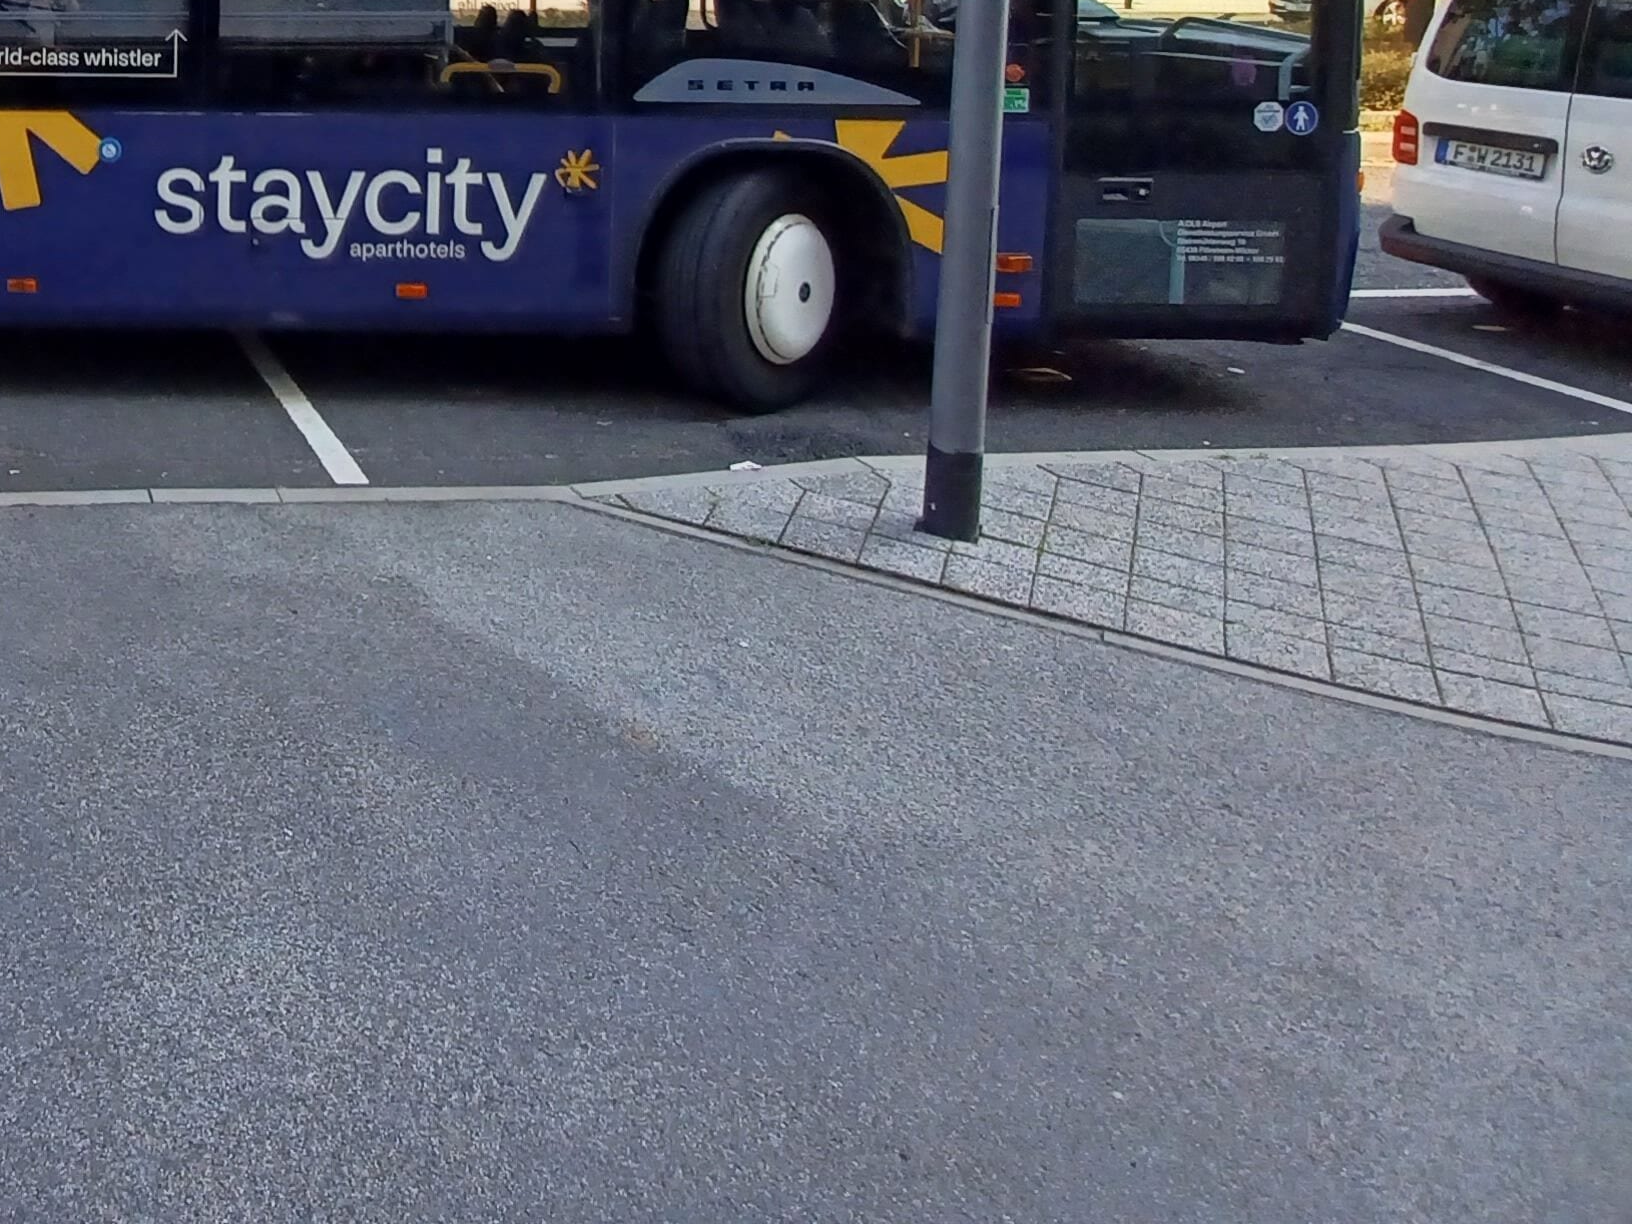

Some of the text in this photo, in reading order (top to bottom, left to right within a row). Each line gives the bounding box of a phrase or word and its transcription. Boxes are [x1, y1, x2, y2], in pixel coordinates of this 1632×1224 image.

[84, 48, 162, 67] whistler
[687, 79, 815, 91] SETRA
[154, 148, 547, 262] staycity
[349, 239, 467, 259] aparthotels
